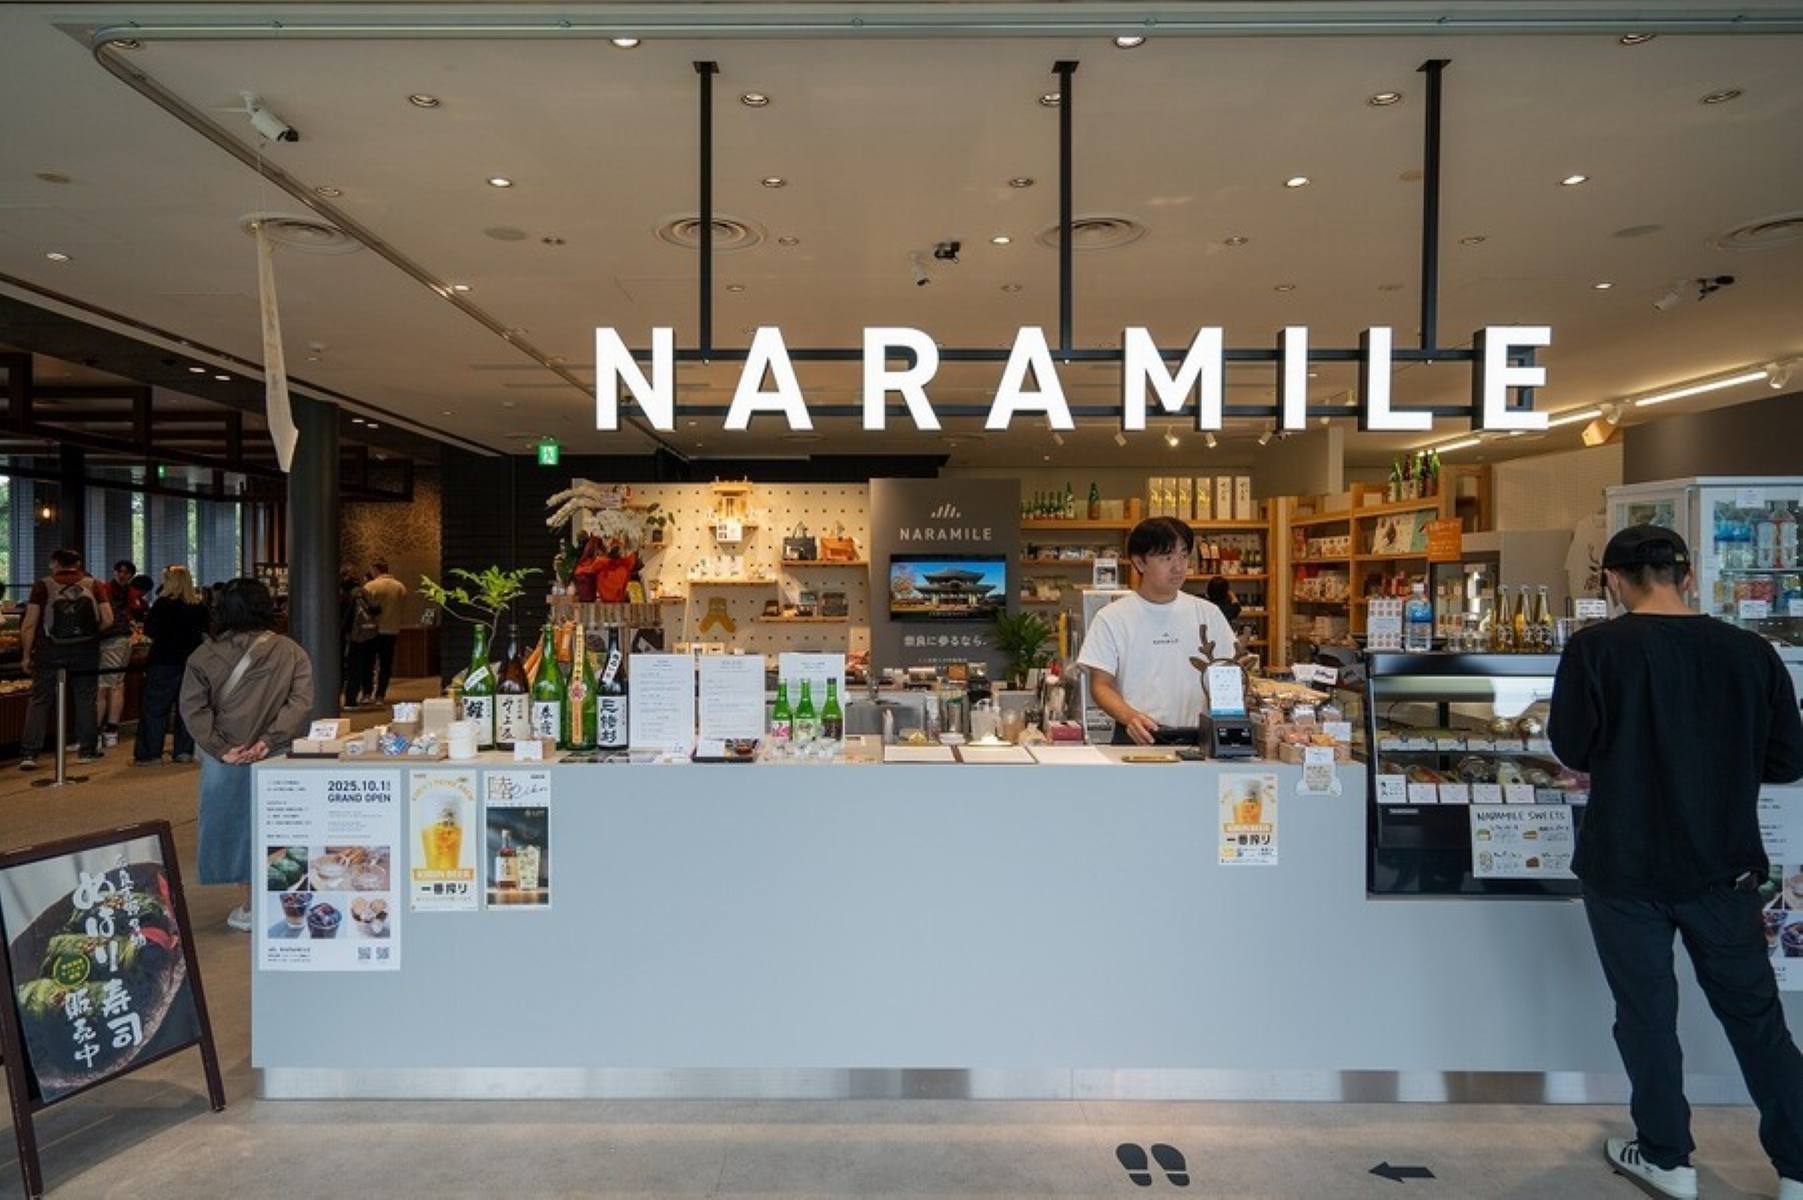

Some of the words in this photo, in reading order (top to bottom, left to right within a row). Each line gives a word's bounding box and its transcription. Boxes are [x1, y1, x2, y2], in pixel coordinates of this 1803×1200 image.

[595, 326, 1552, 432] NARAMILE
[899, 527, 993, 541] NARAMILE
[327, 780, 391, 792] 2025.10.11
[327, 793, 363, 804] GRAND
[364, 793, 391, 804] OPEN
